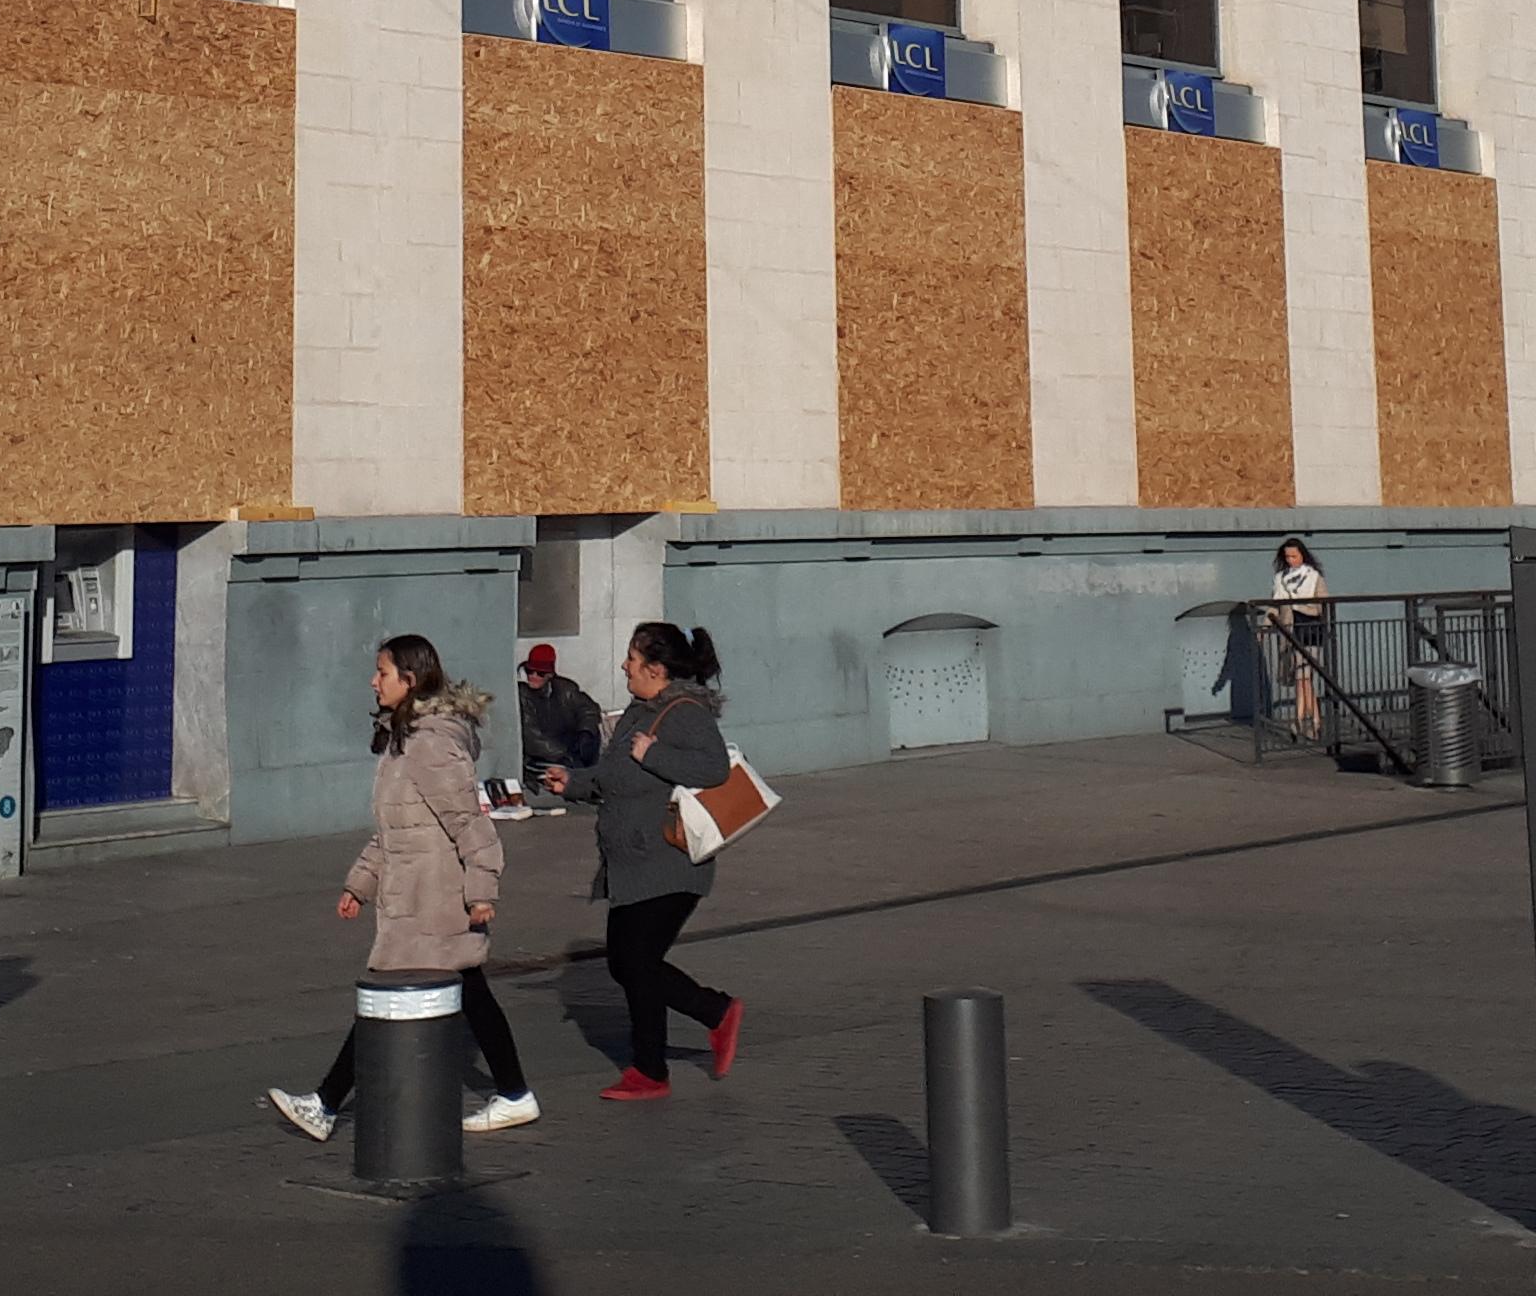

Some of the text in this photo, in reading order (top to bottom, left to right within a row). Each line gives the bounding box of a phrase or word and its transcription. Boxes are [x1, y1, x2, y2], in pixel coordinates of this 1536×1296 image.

[892, 40, 939, 72] LCL
[1169, 83, 1210, 113] LCL
[1400, 121, 1434, 147] LCL
